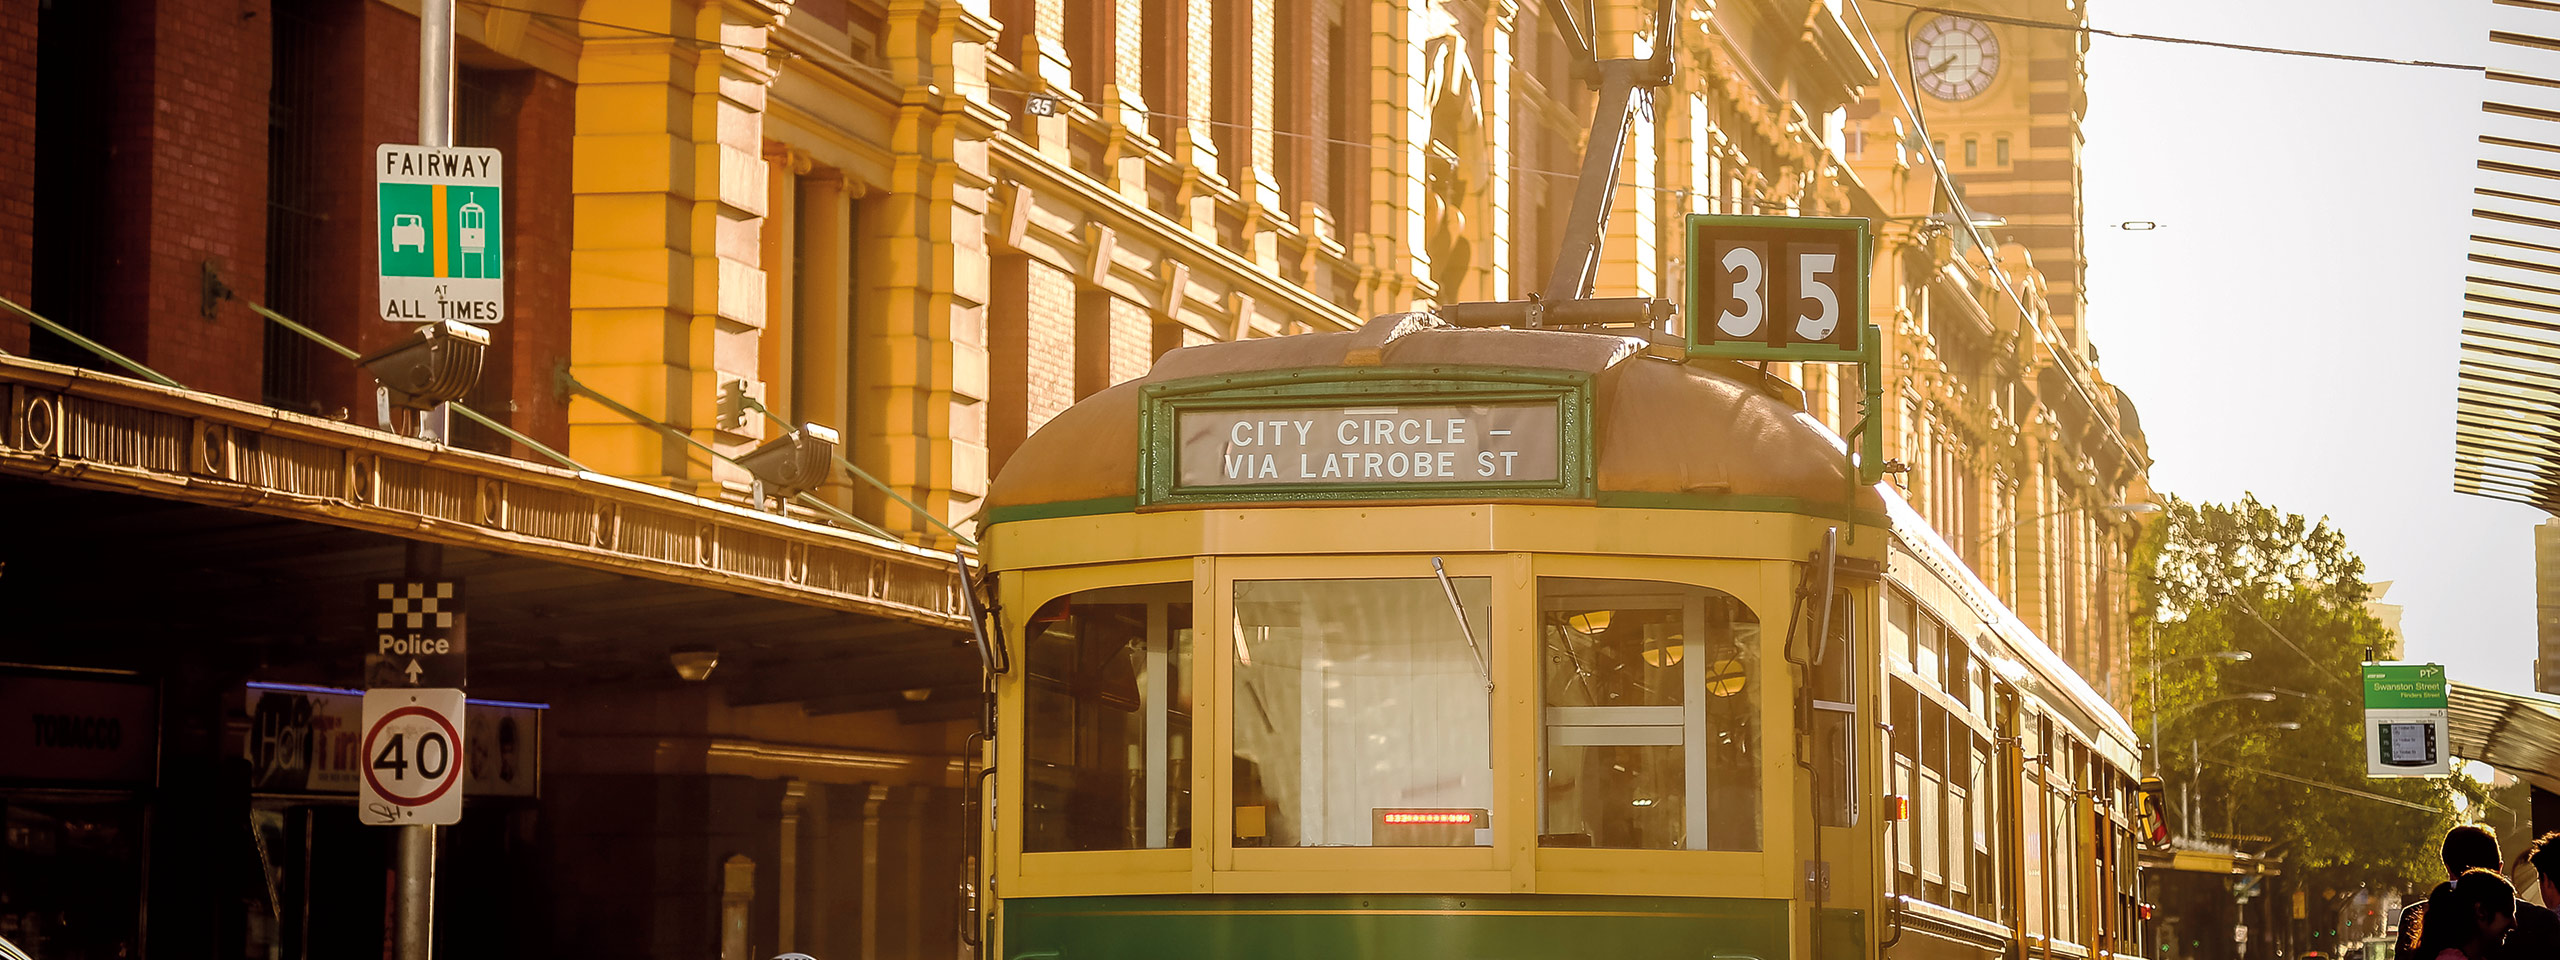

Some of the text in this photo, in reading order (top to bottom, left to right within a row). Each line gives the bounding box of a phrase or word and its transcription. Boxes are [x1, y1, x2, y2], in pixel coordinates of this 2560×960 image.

[1029, 98, 1052, 115] 35
[386, 151, 491, 178] FAIRWAY
[434, 285, 448, 295] AT
[386, 299, 498, 320] ALL TIMES
[1231, 420, 1314, 447] CITY
[1337, 419, 1466, 445] CIRCLE
[1224, 451, 1519, 479] VIA LATROBE ST
[379, 634, 450, 655] Police
[2373, 682, 2440, 691] Swanston Street
[31, 712, 122, 751] TOBACCO
[260, 712, 309, 771] Hair
[373, 731, 448, 781] 40
